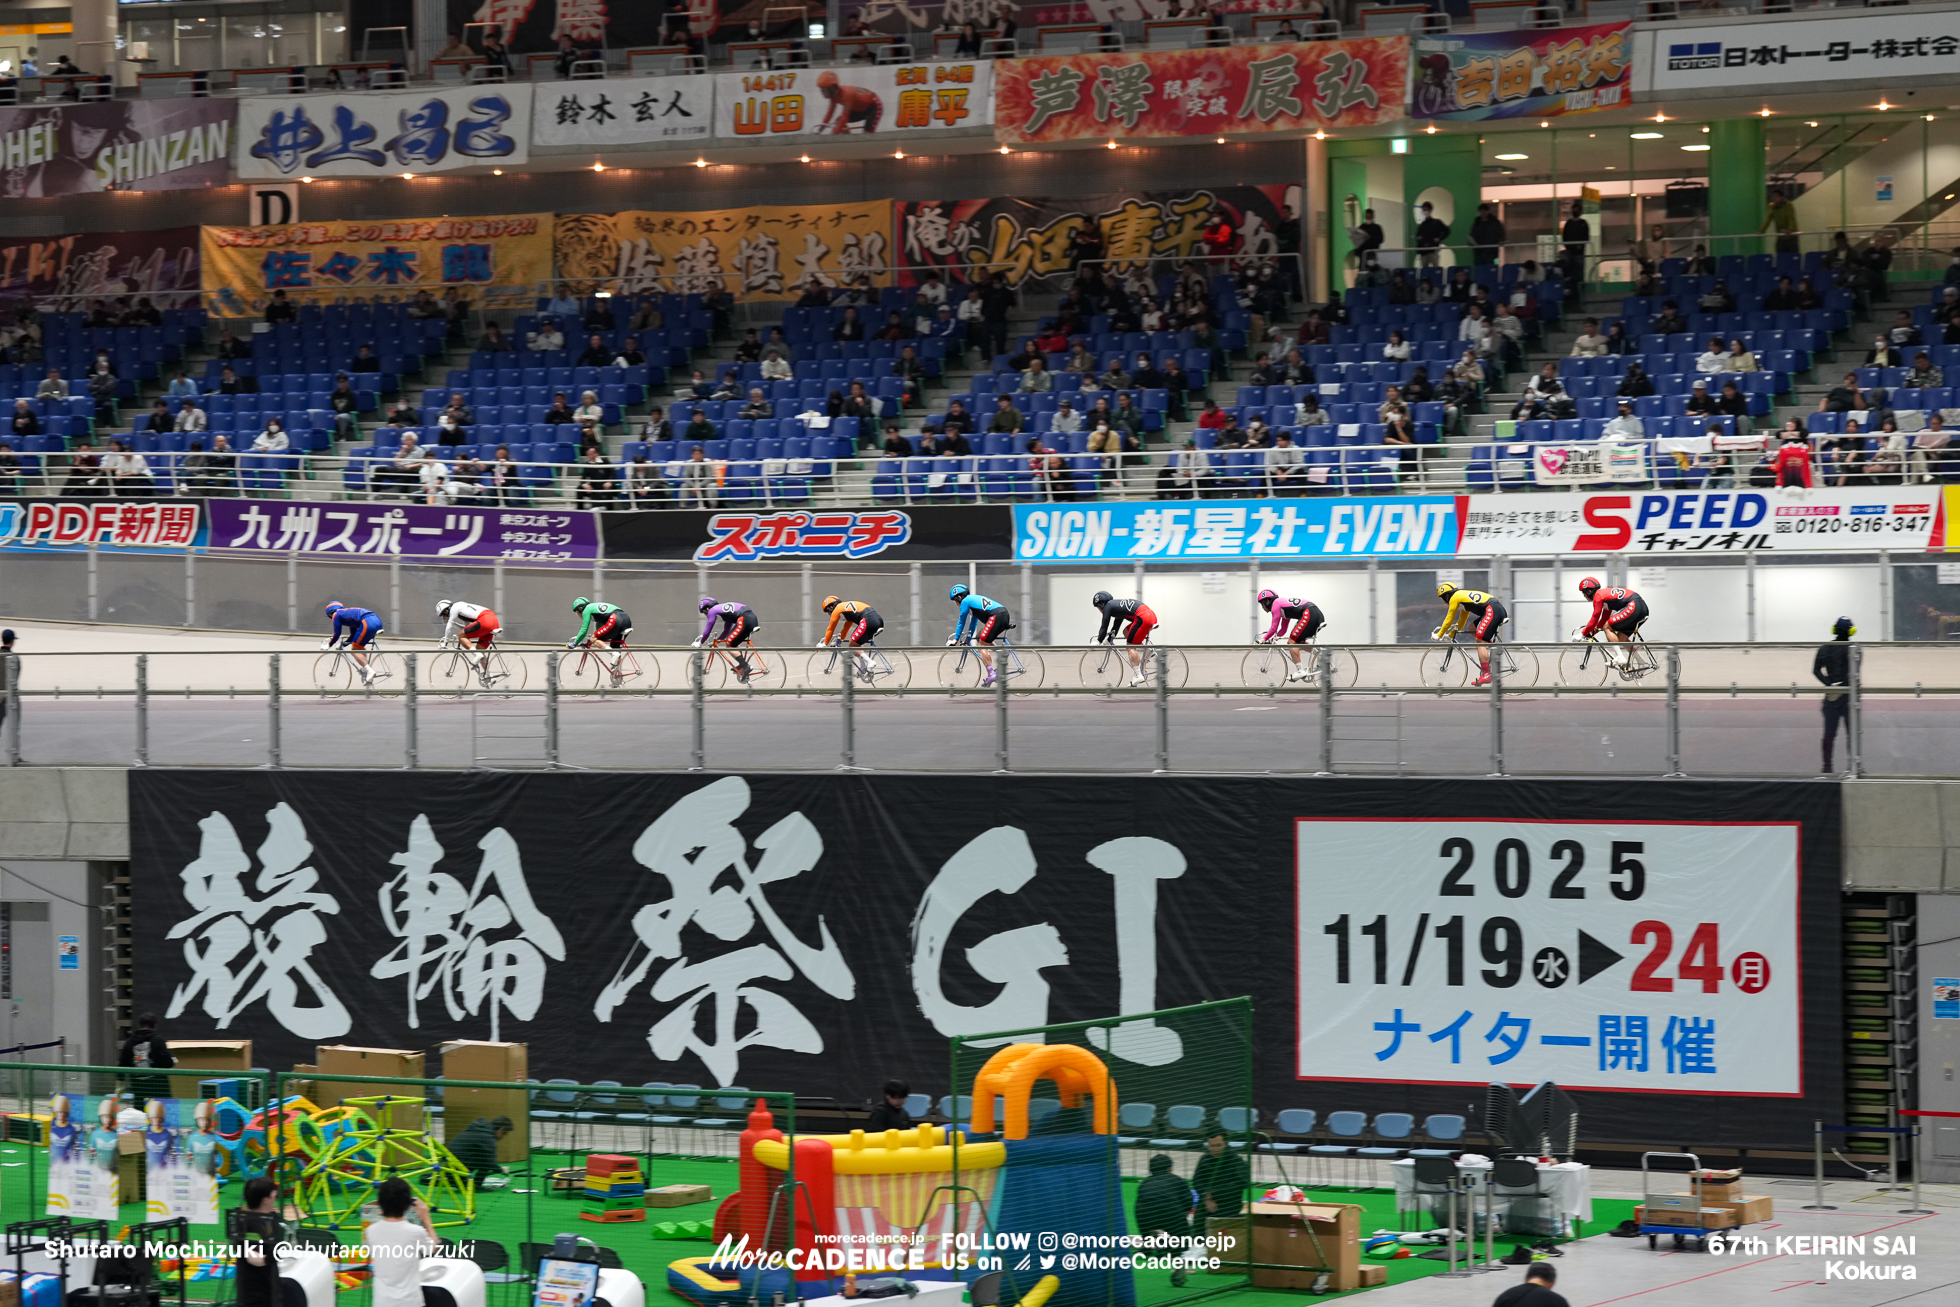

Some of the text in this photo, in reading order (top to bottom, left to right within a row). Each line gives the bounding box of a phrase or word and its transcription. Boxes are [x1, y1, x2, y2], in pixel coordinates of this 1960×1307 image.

[741, 73, 797, 93] 14417
[1237, 50, 1380, 121] 辰弘
[1454, 46, 1537, 111] 吉田
[1541, 31, 1624, 95] 拓矢
[555, 90, 692, 125] 鈴木 玄人
[733, 88, 970, 135] 山田 庸平
[1023, 61, 1154, 133] 芦澤
[0, 122, 53, 170] HEI
[96, 119, 229, 189] SHINZAN
[251, 96, 515, 173] 井上昌己
[255, 190, 292, 226] D
[260, 246, 417, 288] 佐々木
[230, 505, 484, 557] 九州スポーツ
[693, 509, 912, 565] スポニチ
[1572, 493, 1767, 551] SPEED
[1638, 531, 1774, 551] チャンネル
[597, 603, 609, 614] 6
[722, 602, 735, 614] 9
[845, 601, 857, 613] 7
[981, 596, 993, 611] 4
[1120, 598, 1135, 612] 2
[1289, 597, 1302, 608] 8
[1468, 591, 1482, 604] 5
[1611, 587, 1625, 600] 3
[1438, 837, 1645, 901] 2025
[165, 776, 855, 1086] 競輪祭
[1324, 912, 1522, 989] 11/19
[1629, 920, 1724, 994] 24
[1373, 1008, 1718, 1075] ナイター開催
